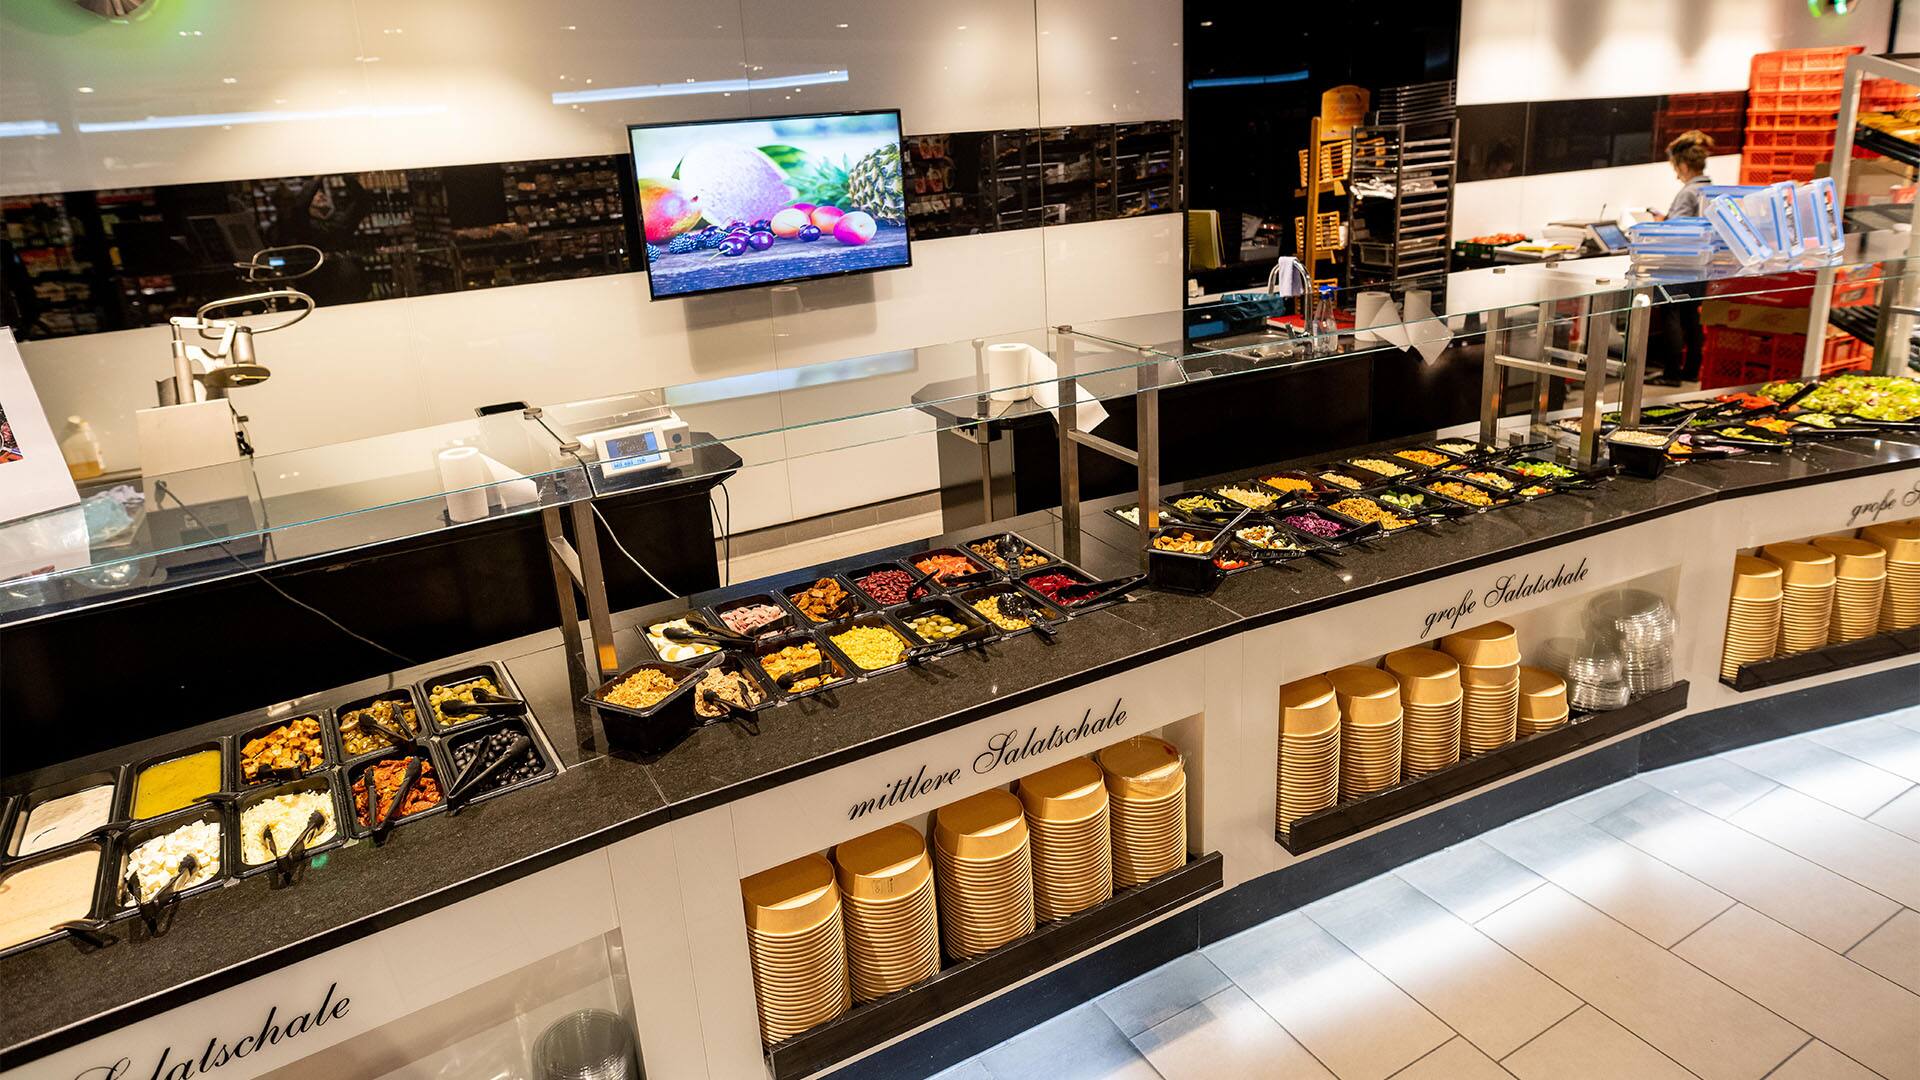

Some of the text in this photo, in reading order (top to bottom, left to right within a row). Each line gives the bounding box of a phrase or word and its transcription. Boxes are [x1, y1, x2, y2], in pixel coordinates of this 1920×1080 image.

[1420, 557, 1589, 639] große Salatschale
[848, 698, 1127, 820] mittlere Salatschale
[75, 982, 350, 1080] latschale
